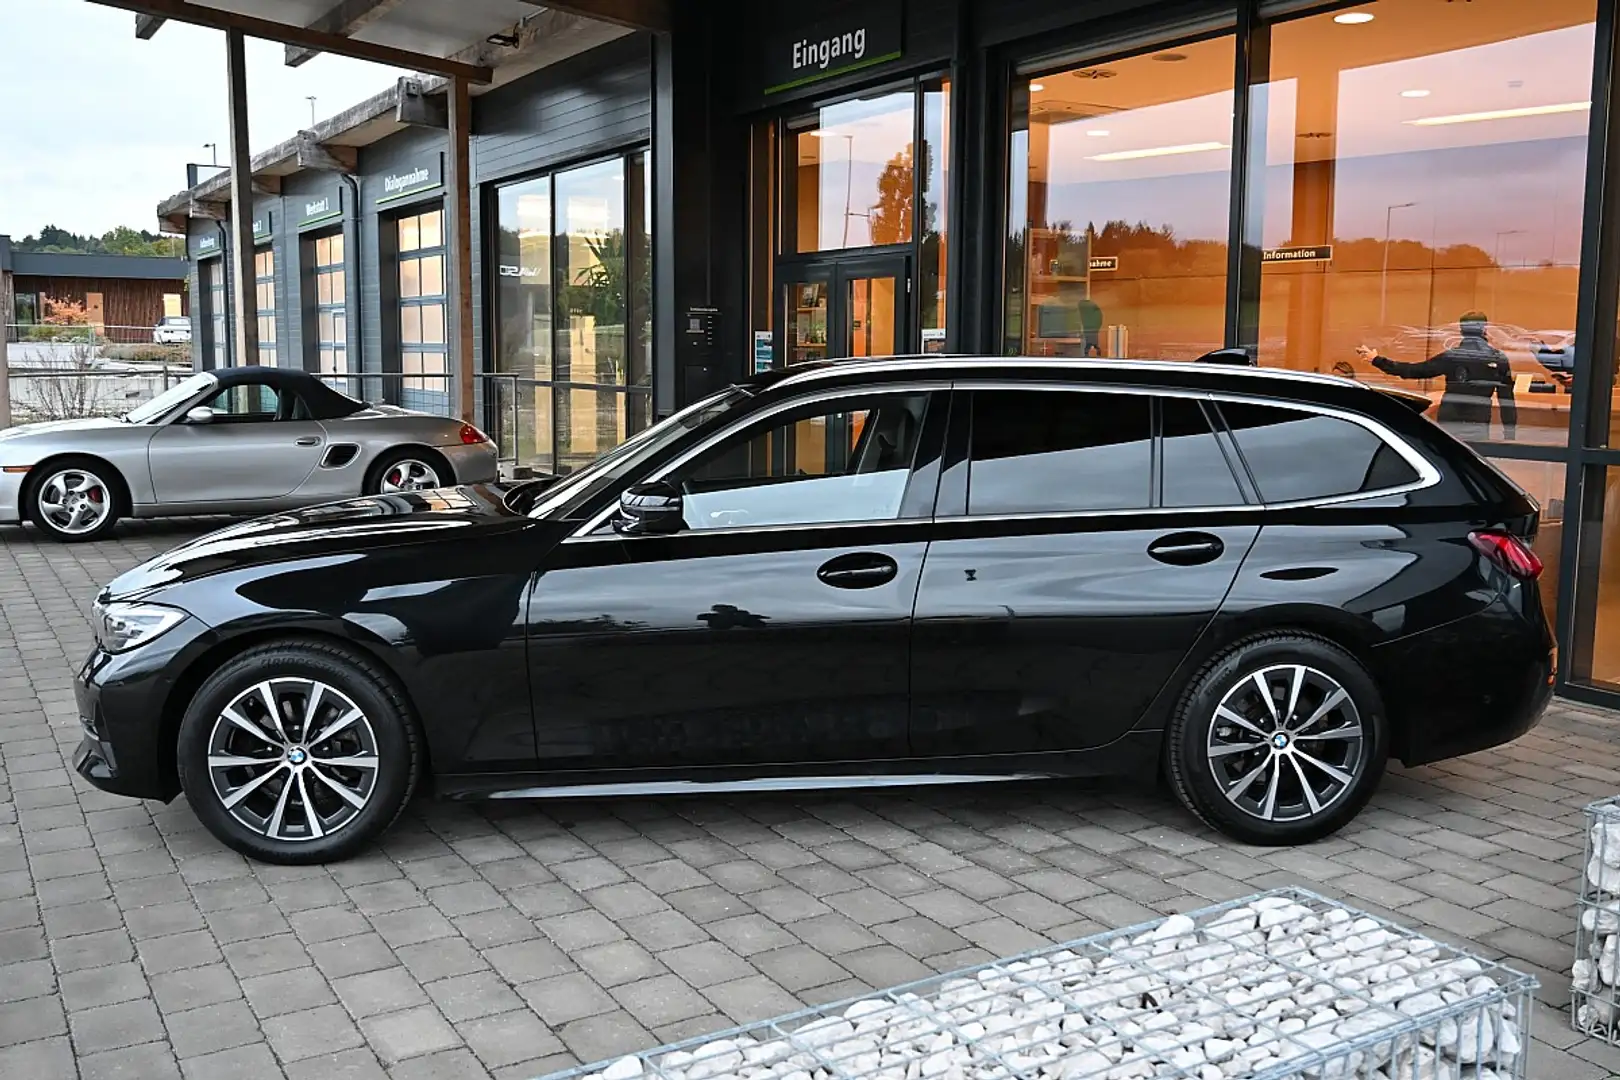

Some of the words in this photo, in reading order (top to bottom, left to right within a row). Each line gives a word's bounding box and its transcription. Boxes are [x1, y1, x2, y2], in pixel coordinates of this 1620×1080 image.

[793, 28, 865, 69] Eingang
[384, 167, 429, 192] Dialogannahme
[1263, 247, 1316, 260] Information
